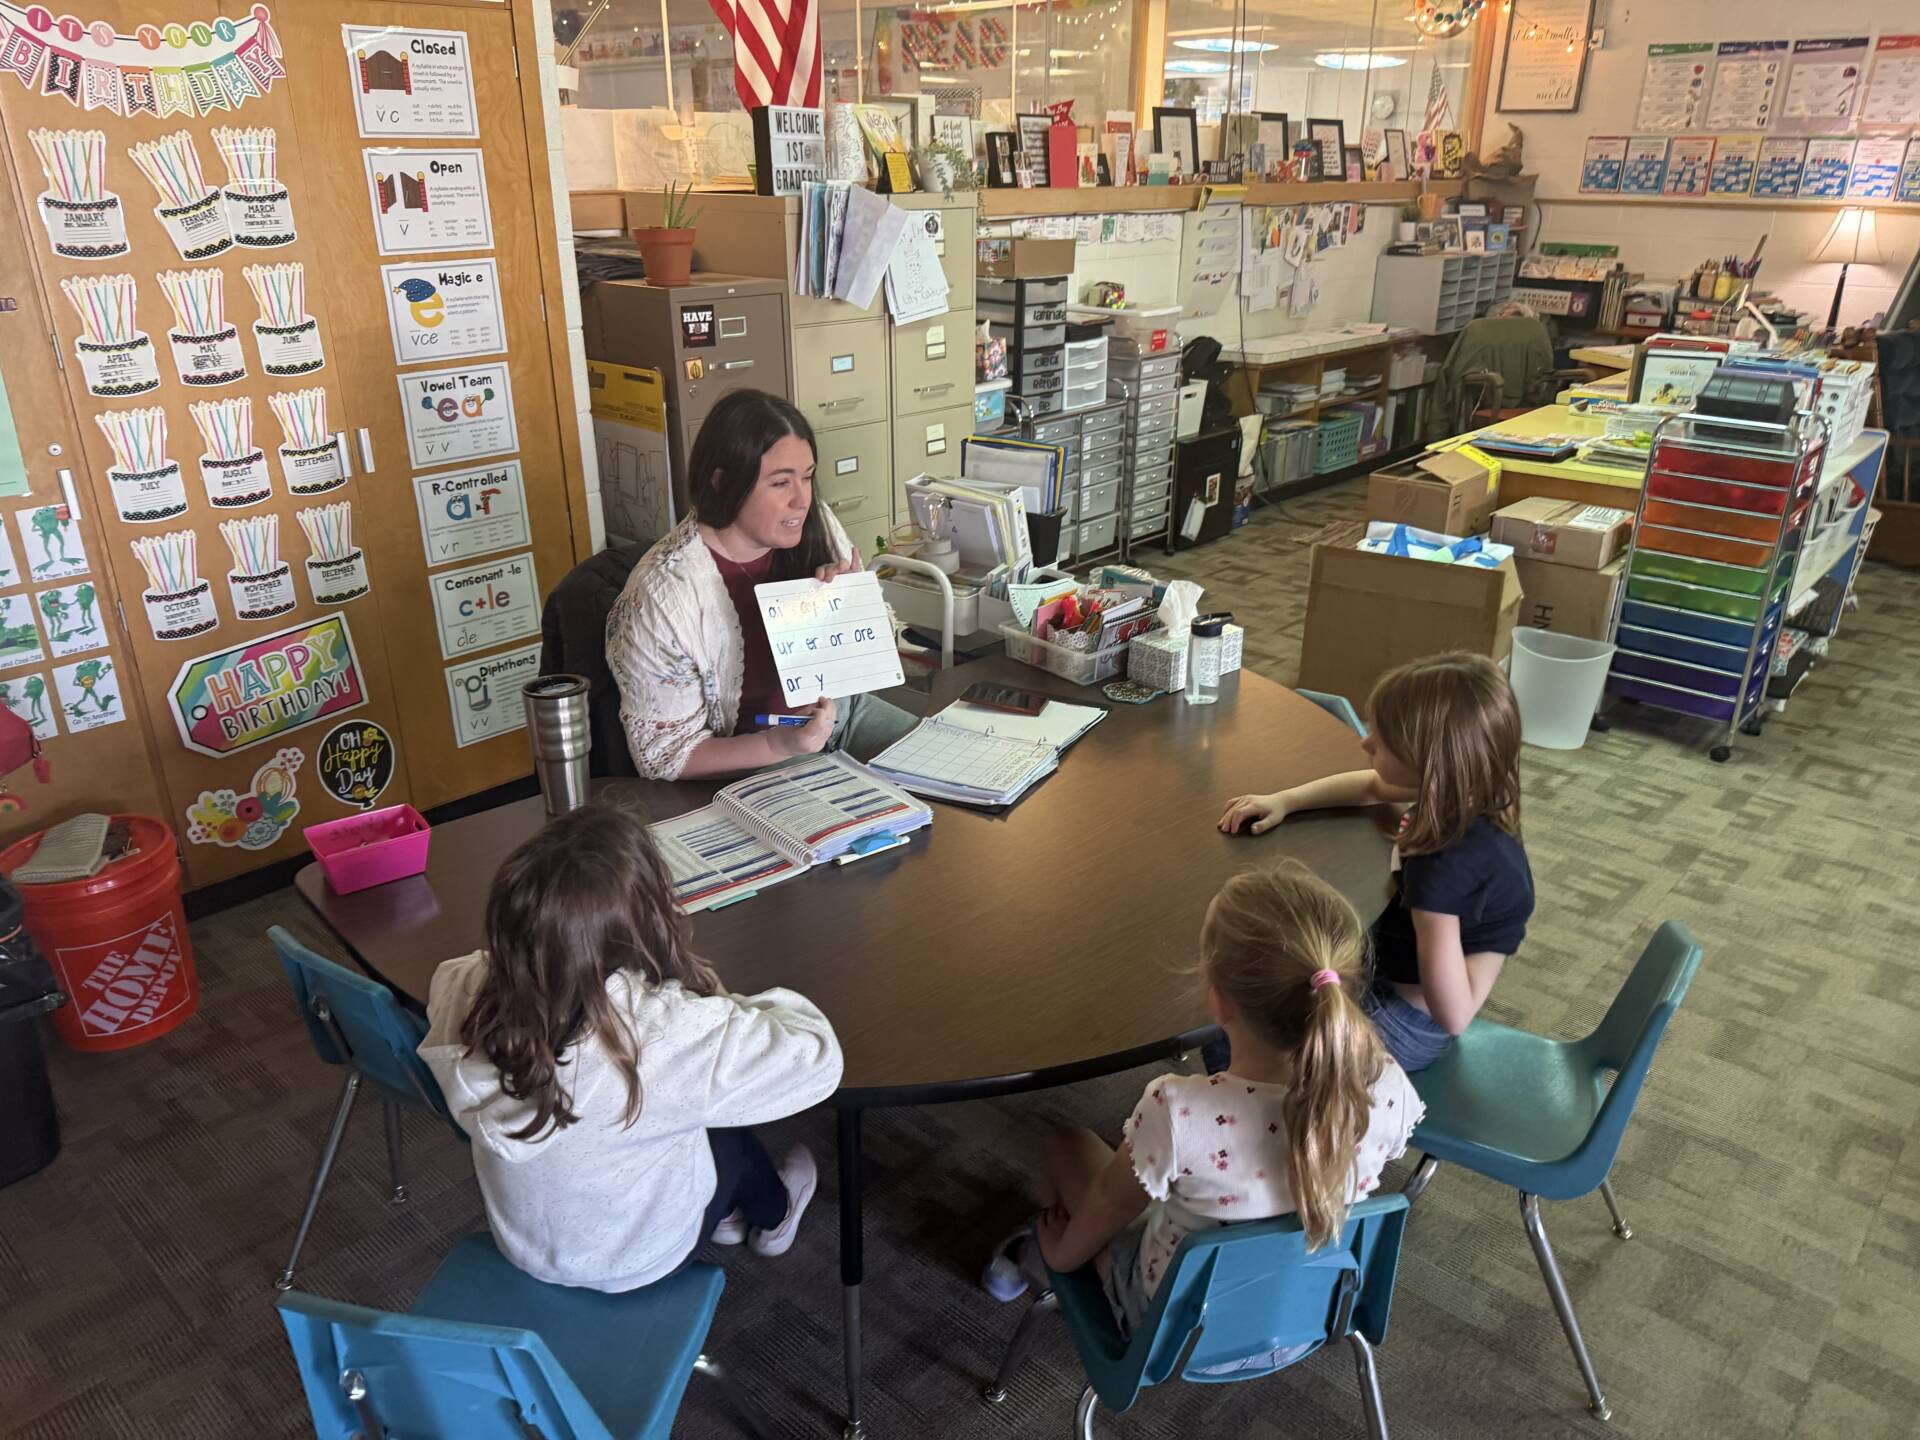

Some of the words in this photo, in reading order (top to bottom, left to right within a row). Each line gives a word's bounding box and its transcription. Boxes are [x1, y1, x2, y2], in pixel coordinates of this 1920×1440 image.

[143, 19, 234, 49] YOUR
[410, 39, 456, 55] Closed
[19, 40, 271, 103] BIRTHDAY
[775, 111, 820, 135] WELCOME
[786, 141, 804, 164] 1ST
[429, 160, 463, 176] Open
[63, 211, 105, 222] JANUARY
[180, 205, 218, 227] FEBRUARY
[247, 204, 276, 214] MARCH
[438, 272, 472, 286] Magic
[476, 273, 483, 282] e
[682, 311, 713, 323] HAVE
[281, 334, 302, 344] JUNE
[106, 351, 133, 364] APRIL
[200, 344, 217, 354] MAY
[420, 376, 456, 393] Vowel
[458, 375, 492, 388] Team
[294, 454, 335, 468] SEPTEMBER
[222, 466, 252, 479] AUGUST
[139, 480, 161, 492] JULY
[431, 469, 508, 496] R-Controlled
[321, 563, 355, 578] DECEMBER
[444, 568, 504, 591] Consonant
[244, 579, 283, 592] NOVEMBER
[163, 598, 201, 612] OCTOBER
[829, 595, 842, 612] ir
[776, 639, 795, 655] ur
[830, 632, 845, 647] or
[854, 626, 876, 643] ore
[205, 630, 337, 712] HAPPY
[479, 654, 537, 677] Diphthong
[786, 675, 803, 692] ar
[815, 672, 824, 692] y
[222, 671, 349, 739] BIRTHDAY!
[340, 730, 362, 749] OH
[325, 743, 383, 772] Happy
[336, 767, 375, 794] Day
[81, 950, 130, 991] THE
[82, 920, 175, 1034] HOME
[130, 948, 181, 1024] DEPOT
